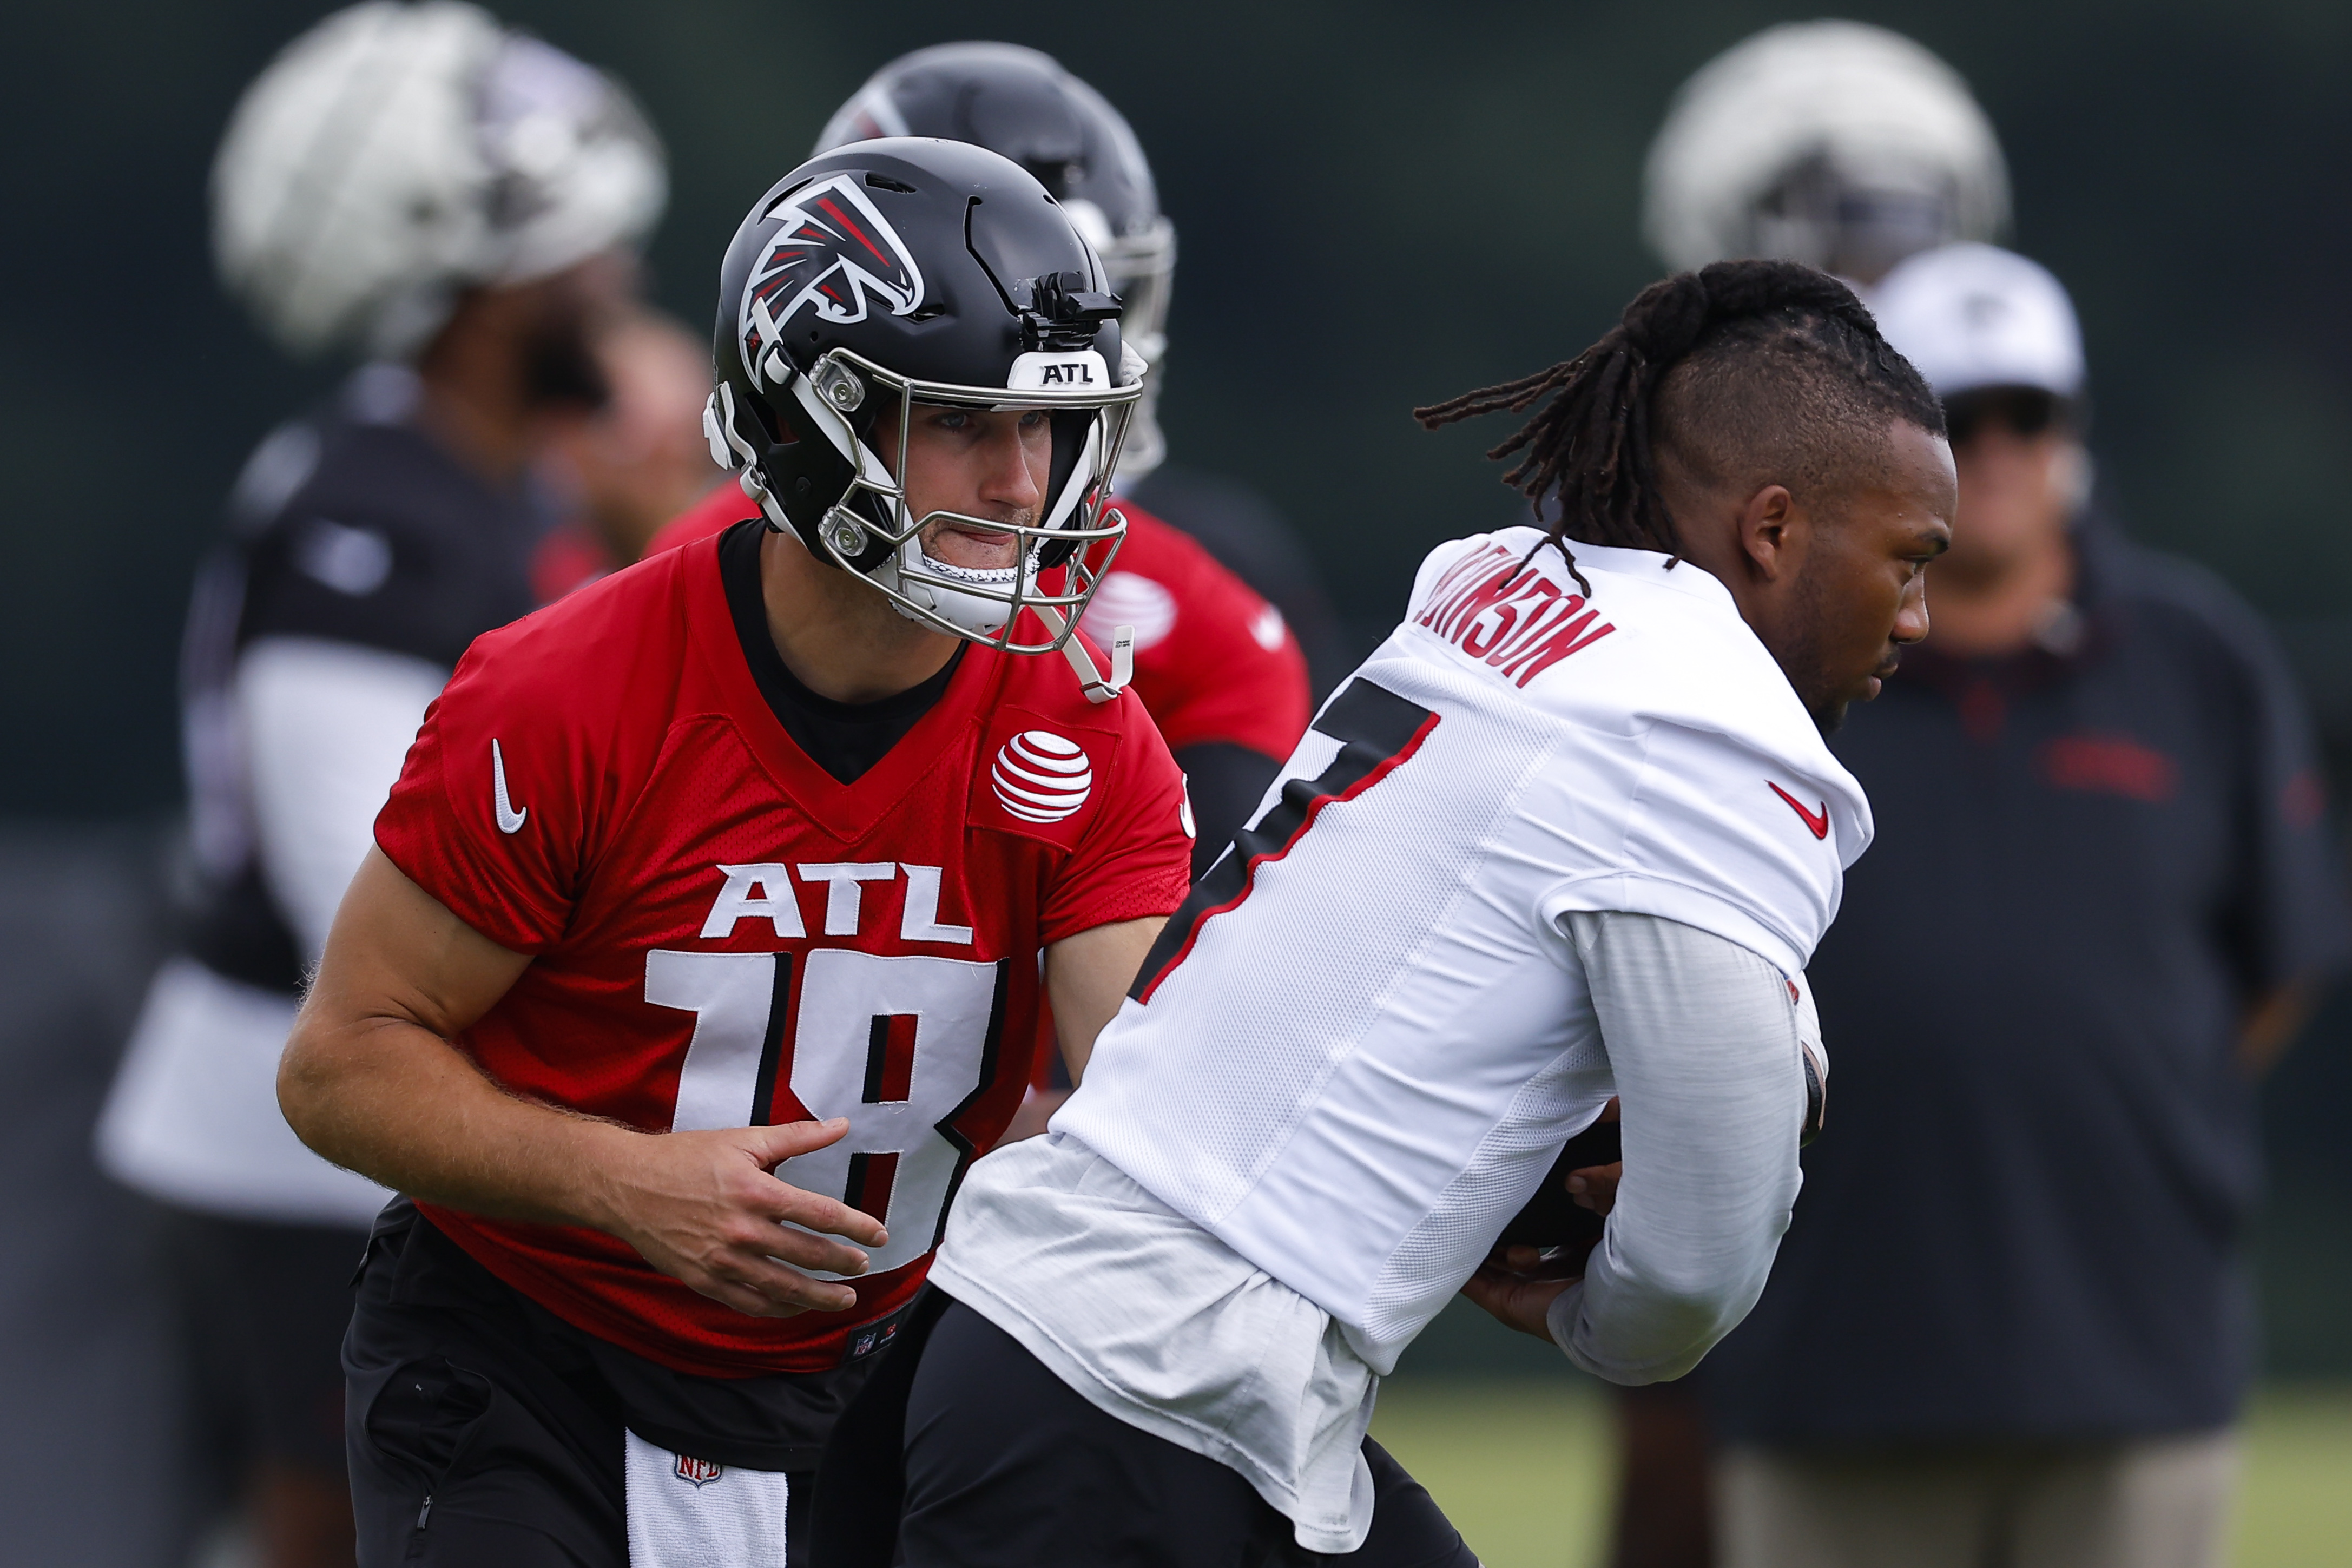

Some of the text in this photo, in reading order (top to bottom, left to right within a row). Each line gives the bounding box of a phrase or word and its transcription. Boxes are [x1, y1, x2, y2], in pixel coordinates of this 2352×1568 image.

[1043, 364, 1093, 385] ATL
[1127, 676, 1441, 1005] 7
[700, 862, 973, 945] ATL
[645, 948, 1010, 1282] 18
[678, 1455, 719, 1480] NFL
